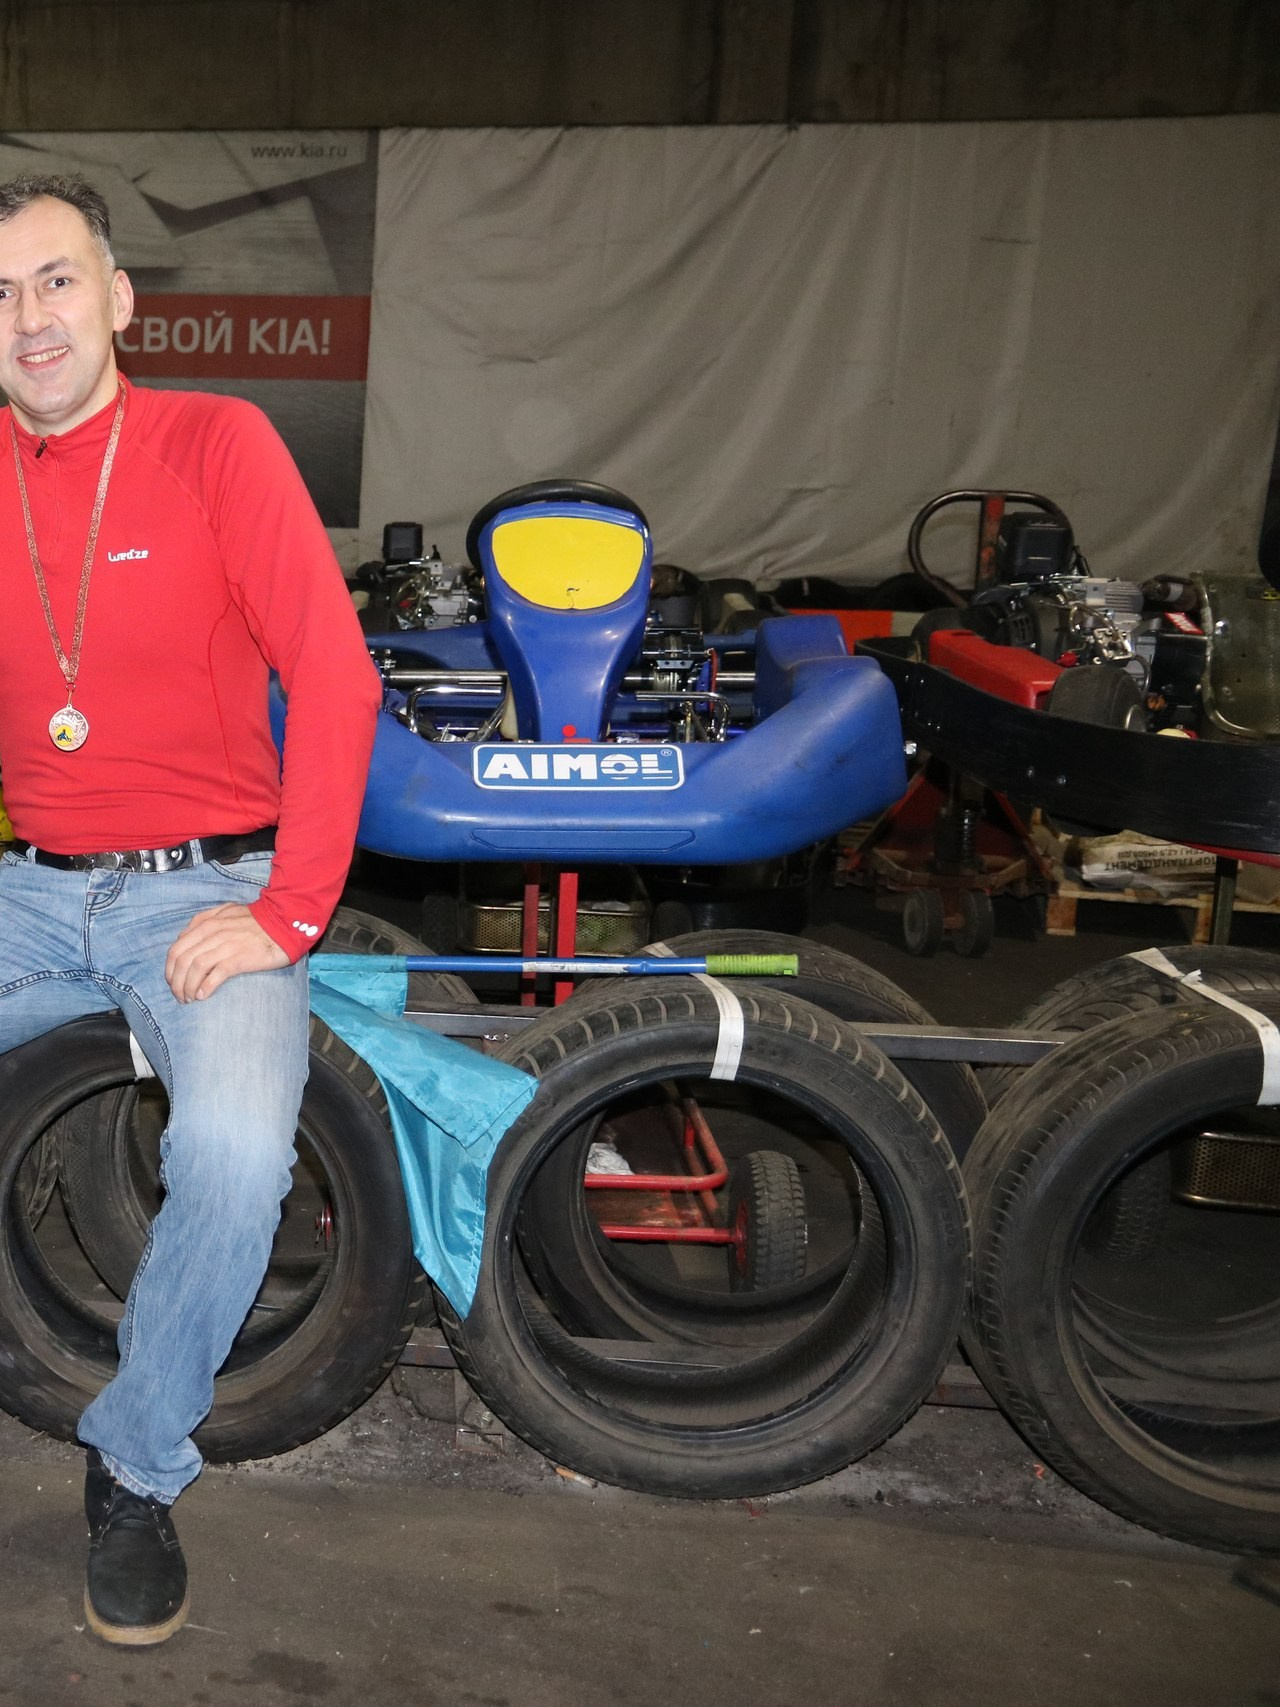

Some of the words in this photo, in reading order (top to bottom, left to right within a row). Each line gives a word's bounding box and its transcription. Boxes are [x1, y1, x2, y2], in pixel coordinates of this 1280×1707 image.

[251, 142, 347, 158] www.kia.ru
[118, 310, 233, 354] СВОЙ
[248, 317, 330, 355] KIA!
[482, 753, 673, 780] AIMOL
